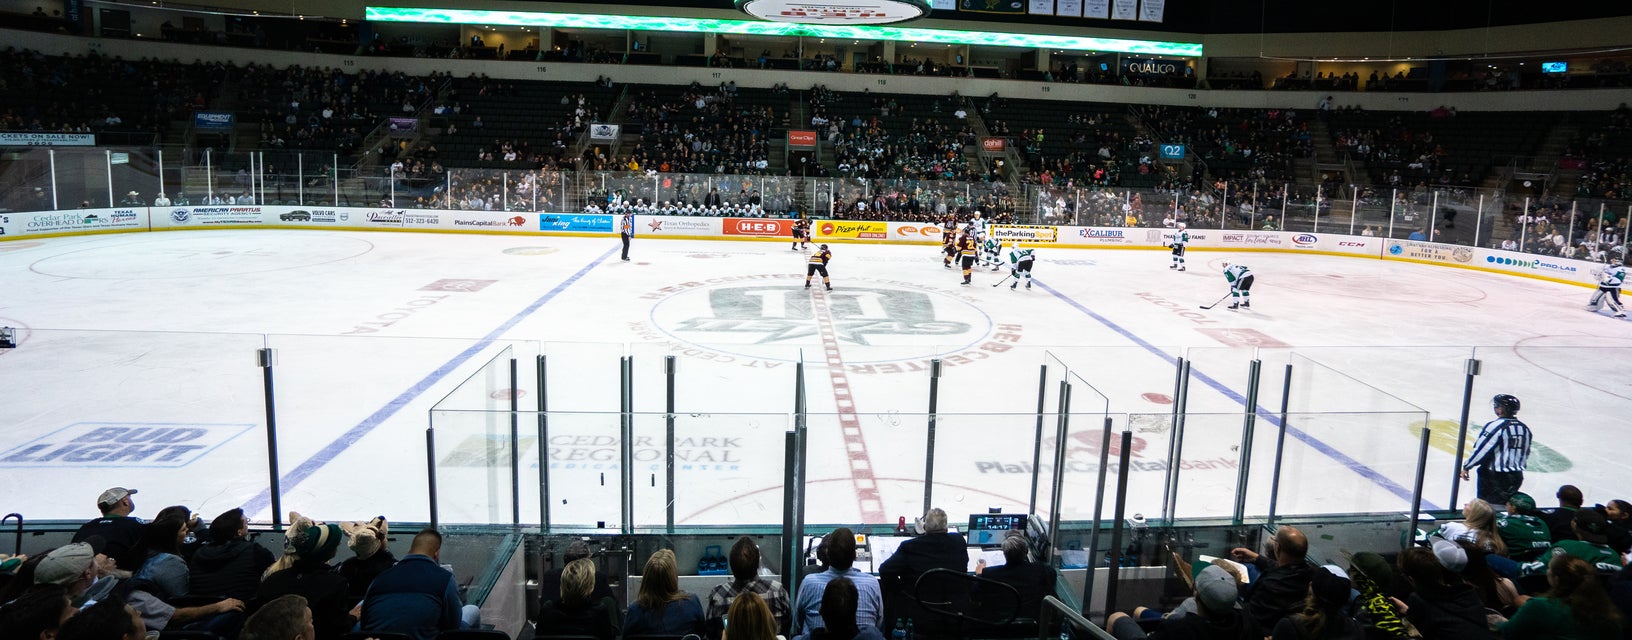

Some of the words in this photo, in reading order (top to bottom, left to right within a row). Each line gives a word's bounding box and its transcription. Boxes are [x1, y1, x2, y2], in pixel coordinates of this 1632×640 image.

[1129, 62, 1176, 74] QUALICO
[1164, 145, 1181, 156] Q2
[835, 225, 856, 234] Pizza
[1079, 228, 1123, 238] EXCALIBUR
[69, 426, 209, 444] BUD
